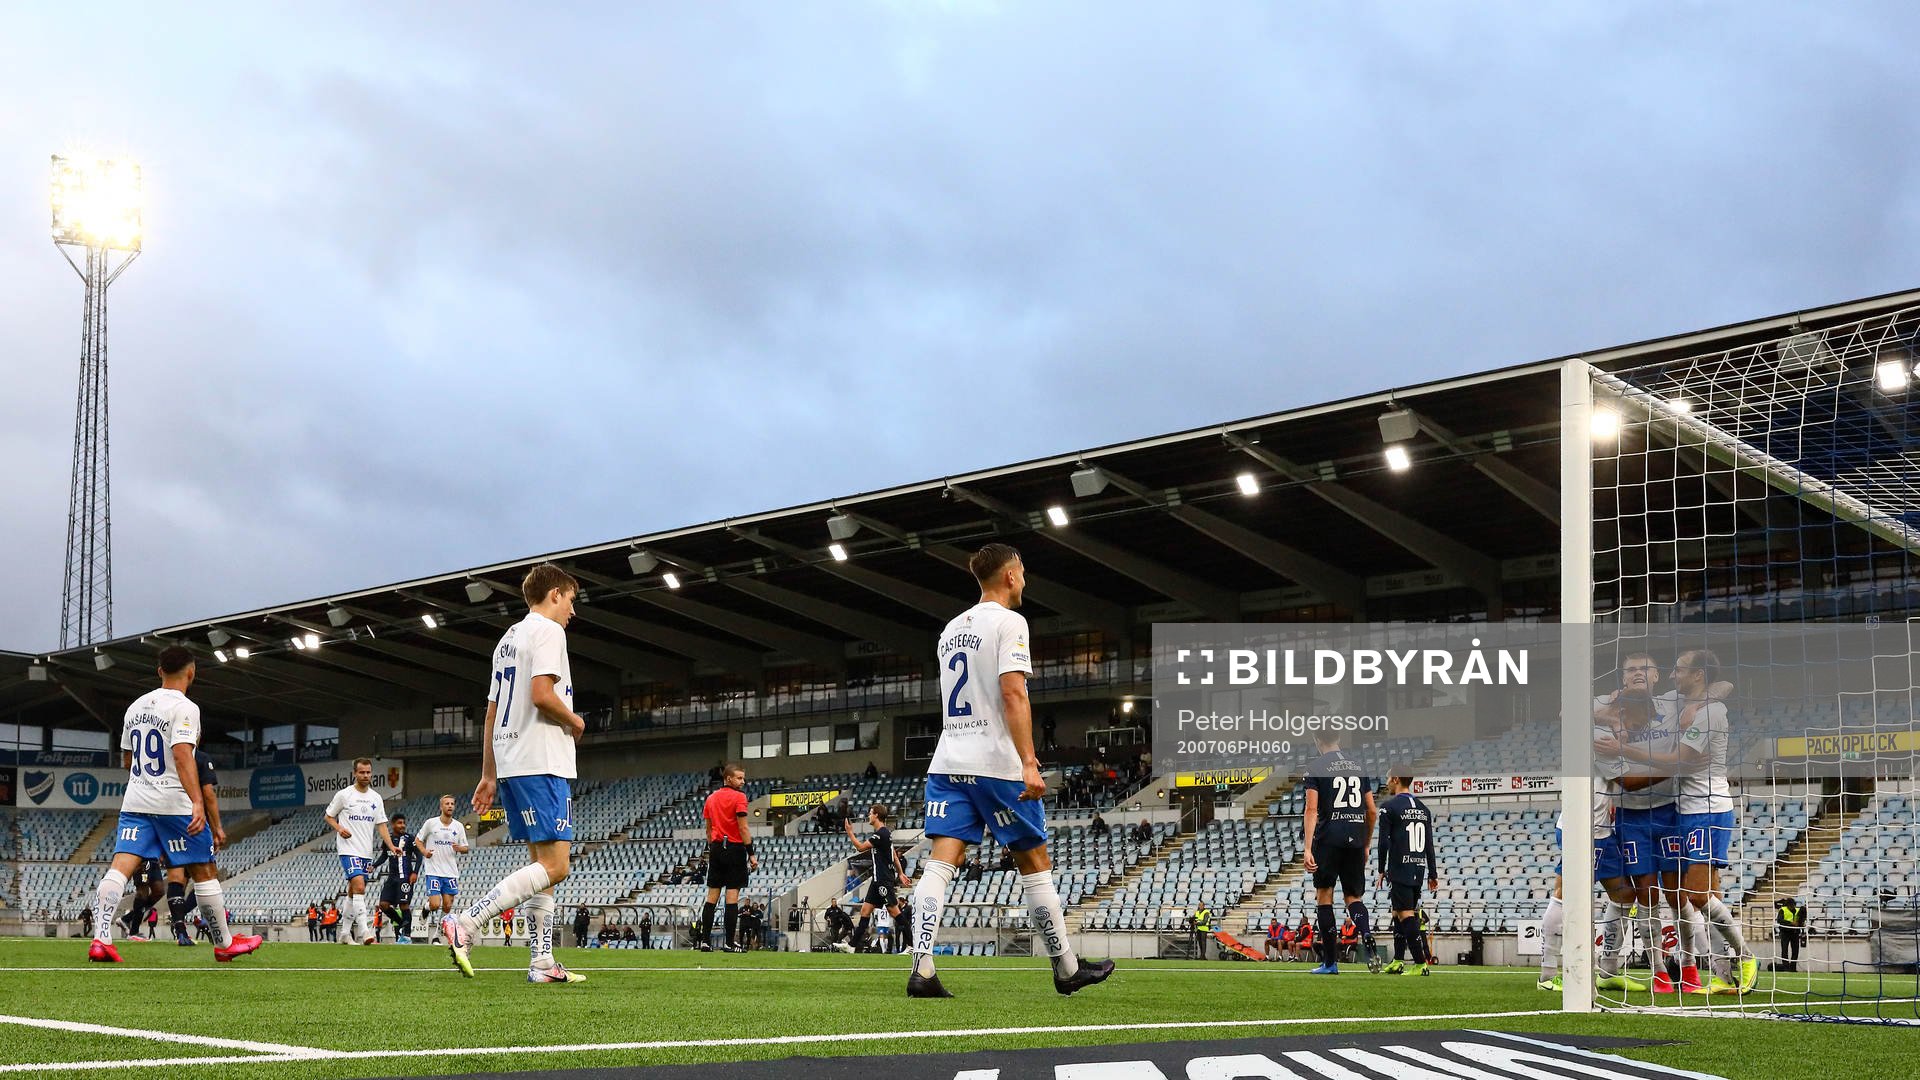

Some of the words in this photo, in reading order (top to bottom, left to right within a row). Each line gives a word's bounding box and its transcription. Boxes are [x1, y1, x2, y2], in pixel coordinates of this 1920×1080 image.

[940, 634, 982, 657] CASTEGREN
[948, 652, 972, 717] 2
[130, 729, 166, 777] 99
[1807, 733, 1898, 755] PACKOPLOCK
[35, 752, 94, 765] Folkpool
[72, 778, 92, 796] nt
[308, 772, 348, 793] Svenska
[1194, 769, 1253, 785] PACKOPLOCK
[784, 792, 825, 806] PACKOPLOCK
[1332, 776, 1362, 808] 23
[521, 806, 537, 827] nt
[926, 800, 949, 819] nt
[121, 826, 140, 841] nt
[556, 819, 567, 832] 27
[168, 836, 188, 852] nt
[1405, 821, 1426, 852] 10
